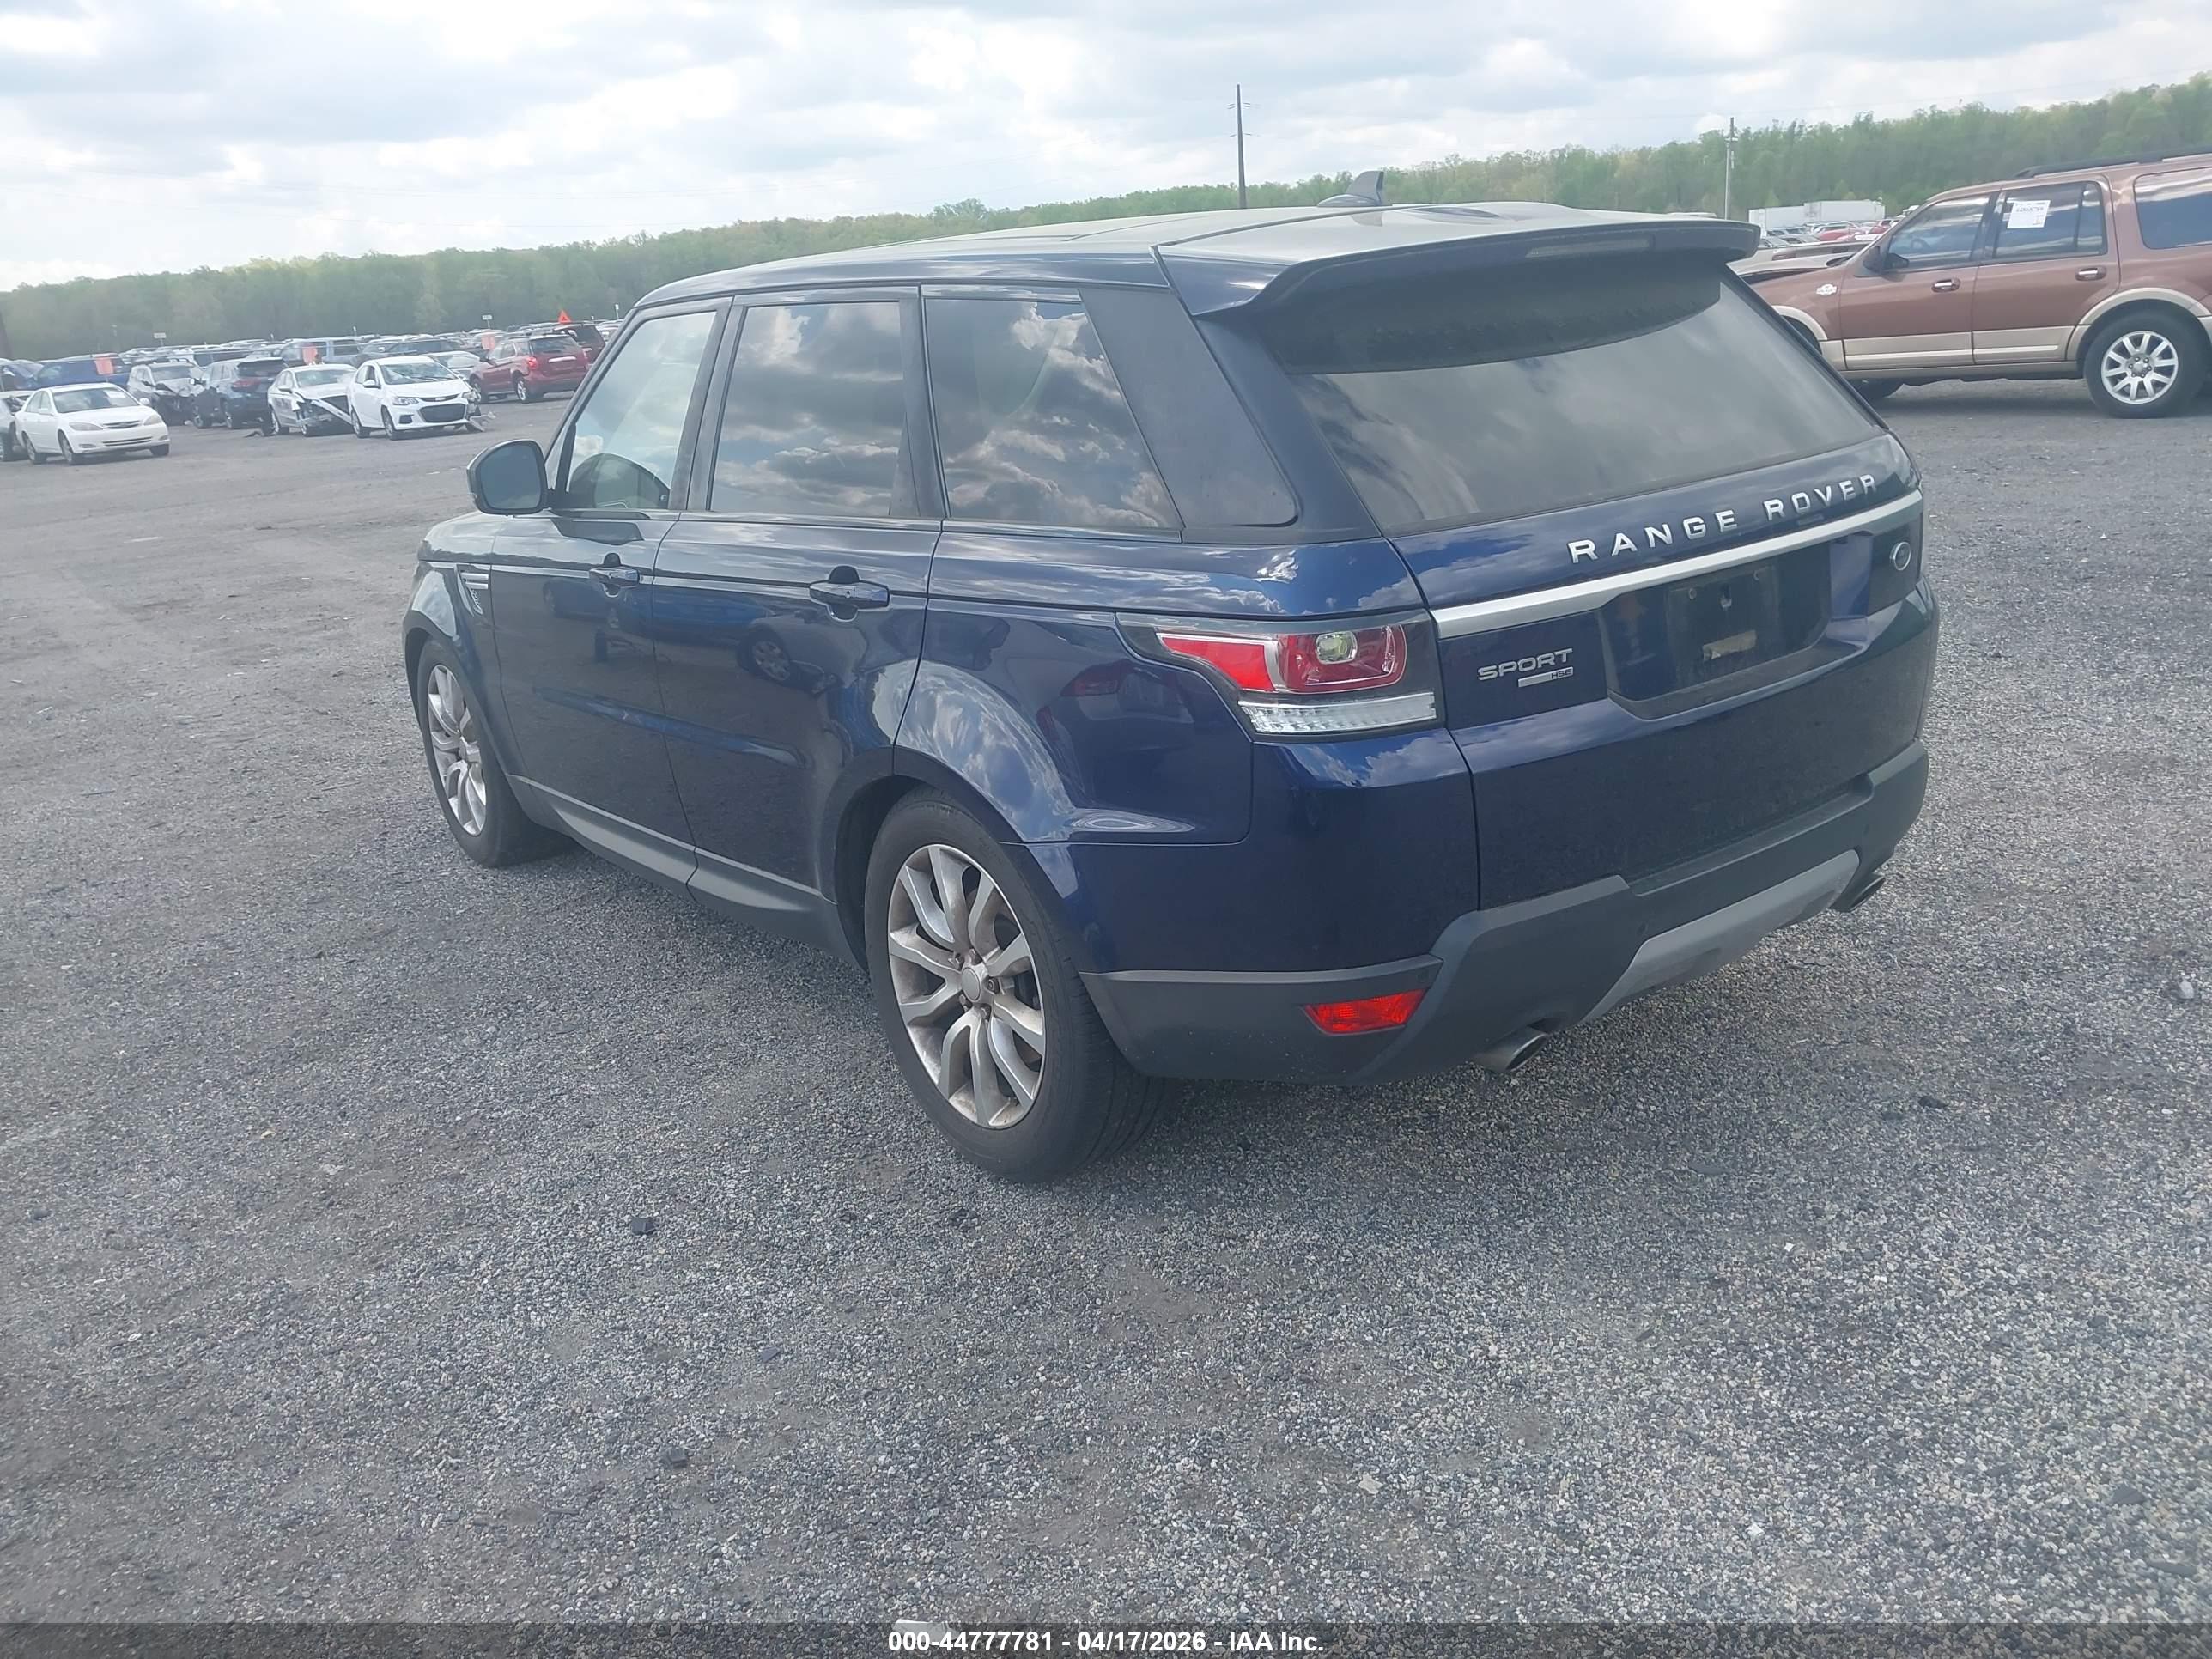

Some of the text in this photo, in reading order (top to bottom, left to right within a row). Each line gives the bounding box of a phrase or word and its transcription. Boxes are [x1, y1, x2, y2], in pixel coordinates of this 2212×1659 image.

[1567, 474, 1877, 564] RANGE ROVER
[1477, 647, 1573, 681] SPORT
[1551, 669, 1572, 680] HSE
